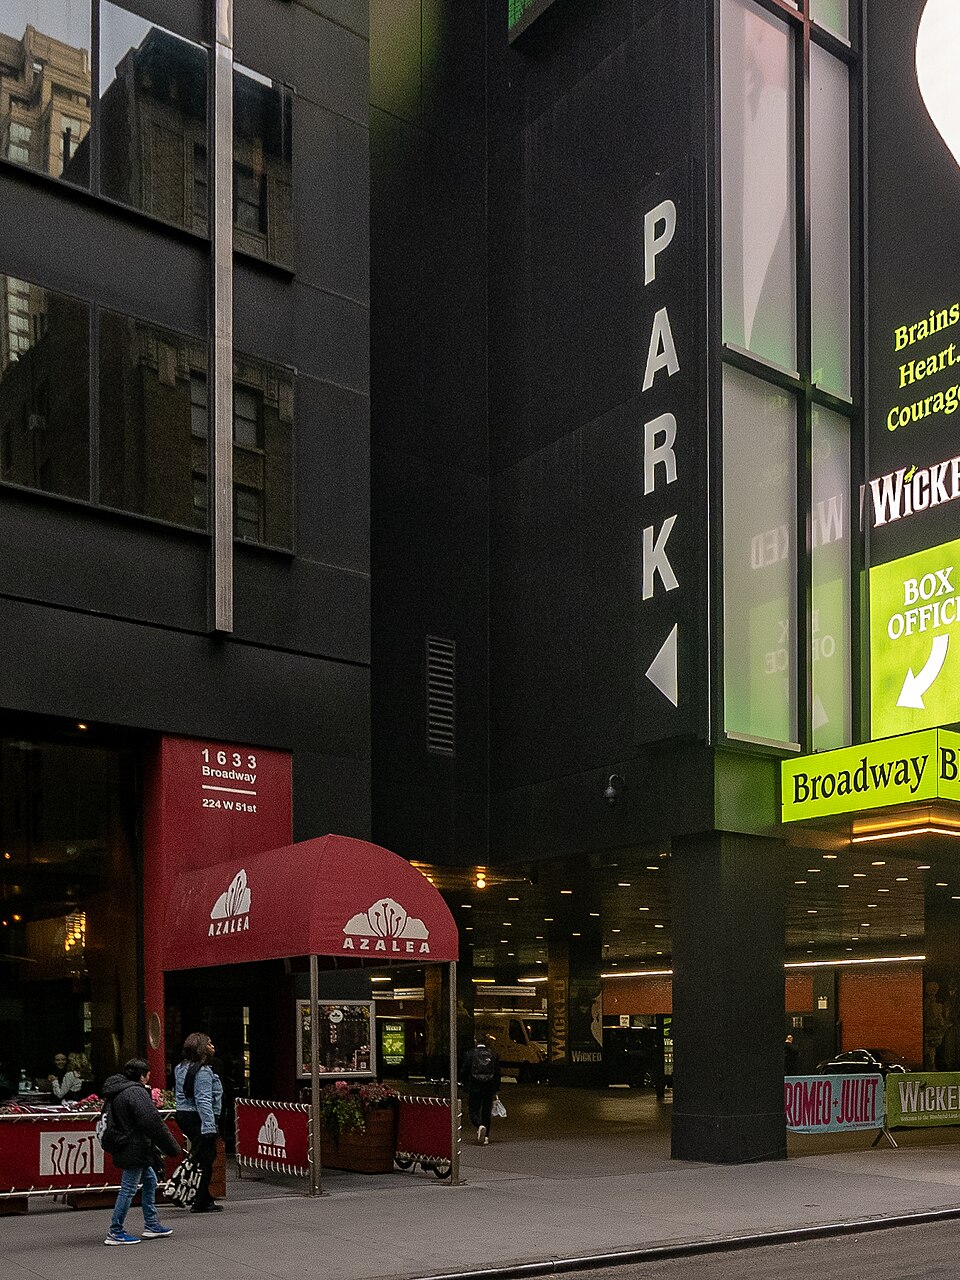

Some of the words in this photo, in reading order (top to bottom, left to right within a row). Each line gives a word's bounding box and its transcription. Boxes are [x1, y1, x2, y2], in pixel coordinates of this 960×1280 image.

[642, 199, 680, 600] PARK
[903, 566, 955, 606] BOX
[201, 748, 257, 769] 1633
[201, 765, 257, 784] Broadway
[792, 754, 929, 804] Broadway
[202, 798, 221, 808] 224
[222, 800, 234, 810] W
[235, 802, 257, 813] 51st
[208, 916, 250, 937] AZALEA
[343, 937, 431, 954] AZALEA
[784, 1080, 832, 1127] ROMEO
[836, 1078, 879, 1123] JULIET
[257, 1144, 287, 1159] AZALEA
